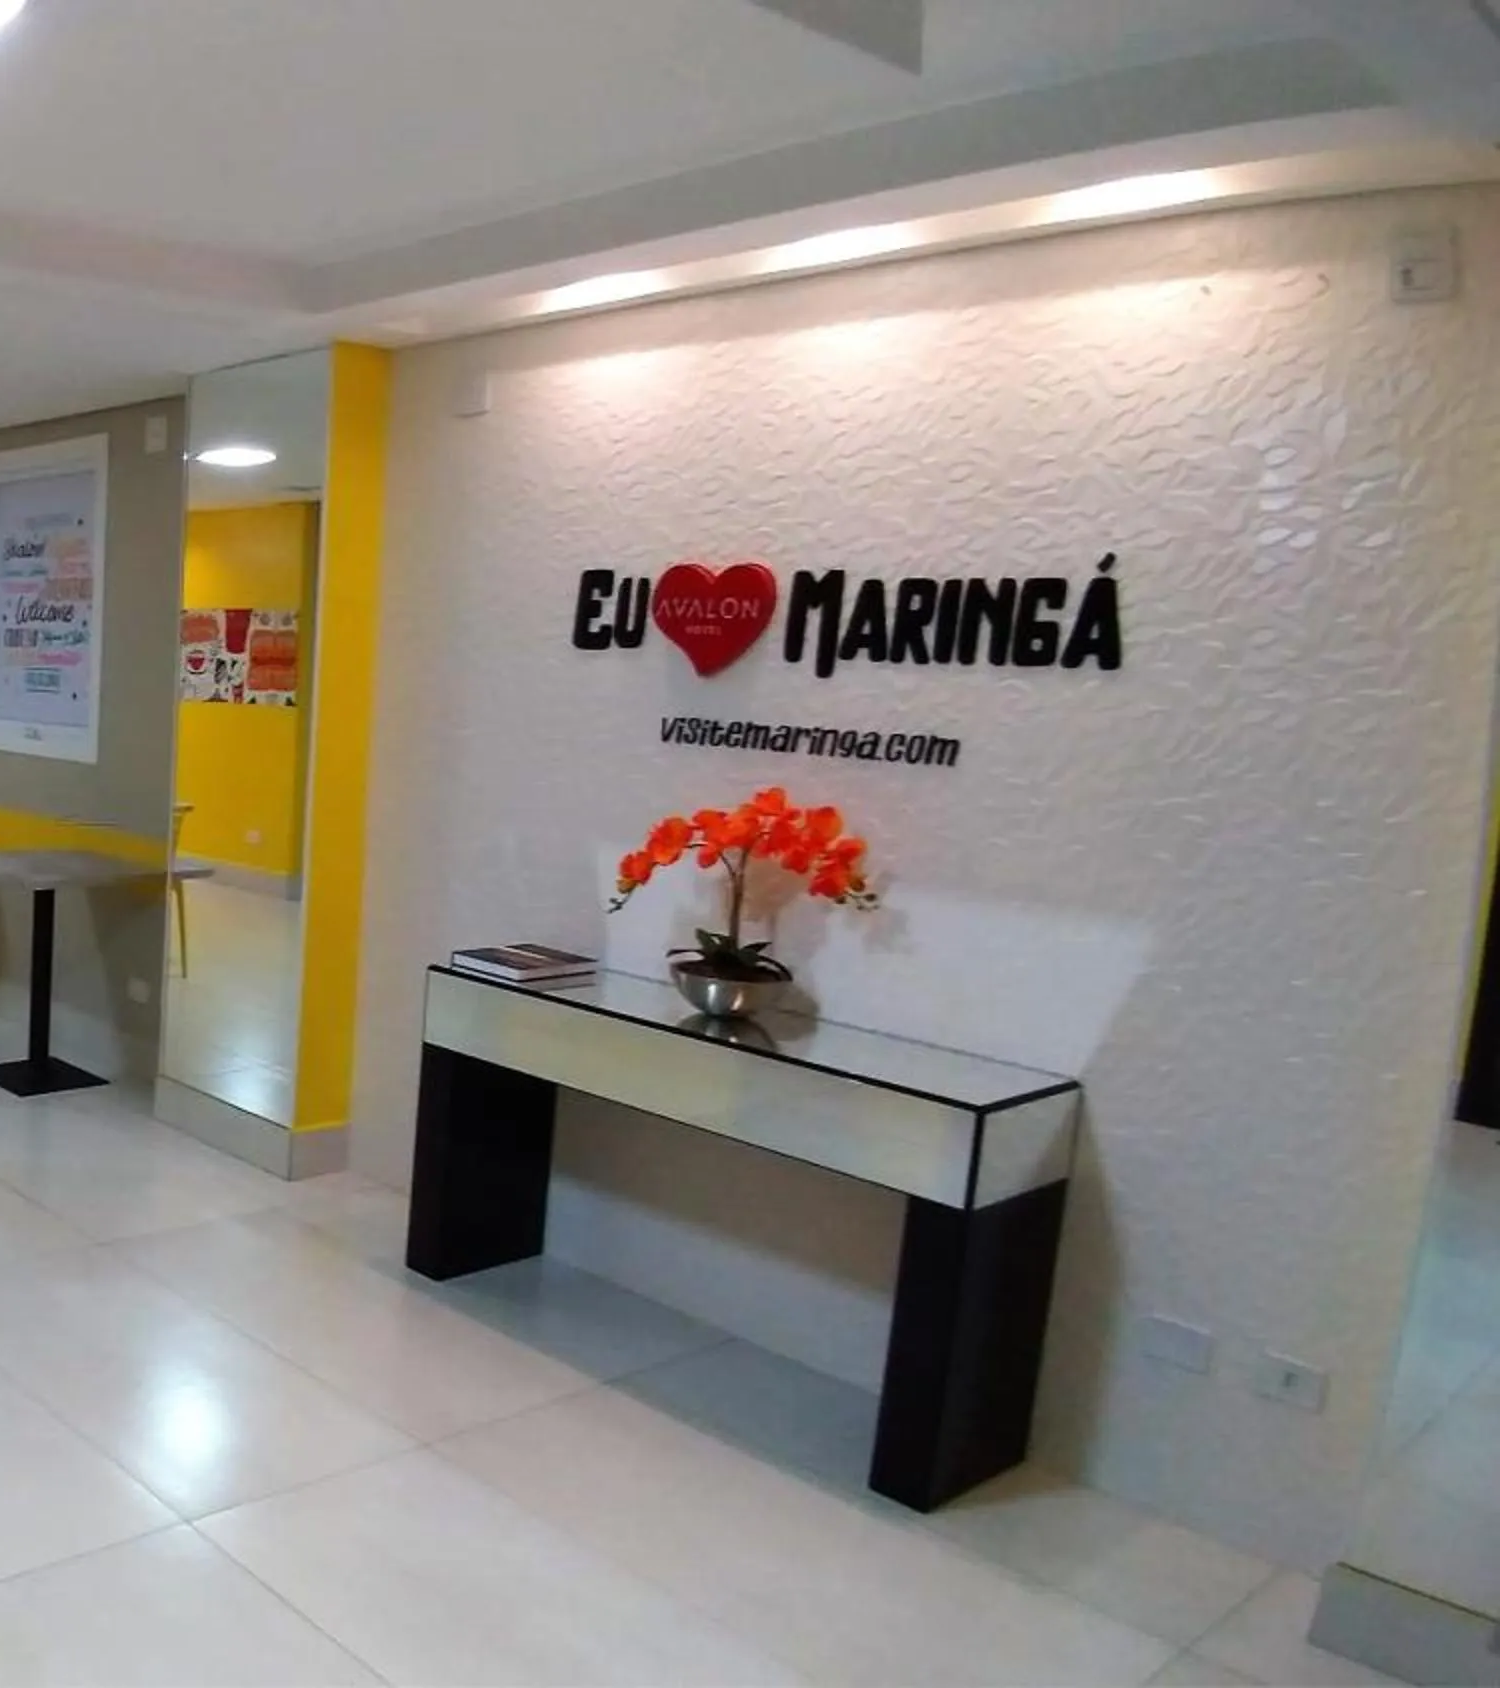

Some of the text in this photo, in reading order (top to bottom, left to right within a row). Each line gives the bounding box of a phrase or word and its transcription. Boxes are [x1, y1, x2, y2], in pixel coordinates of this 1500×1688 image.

[655, 597, 760, 619] AVALON
[783, 552, 1121, 678] MARINGÁ
[660, 717, 961, 767] visitemaringa.com
